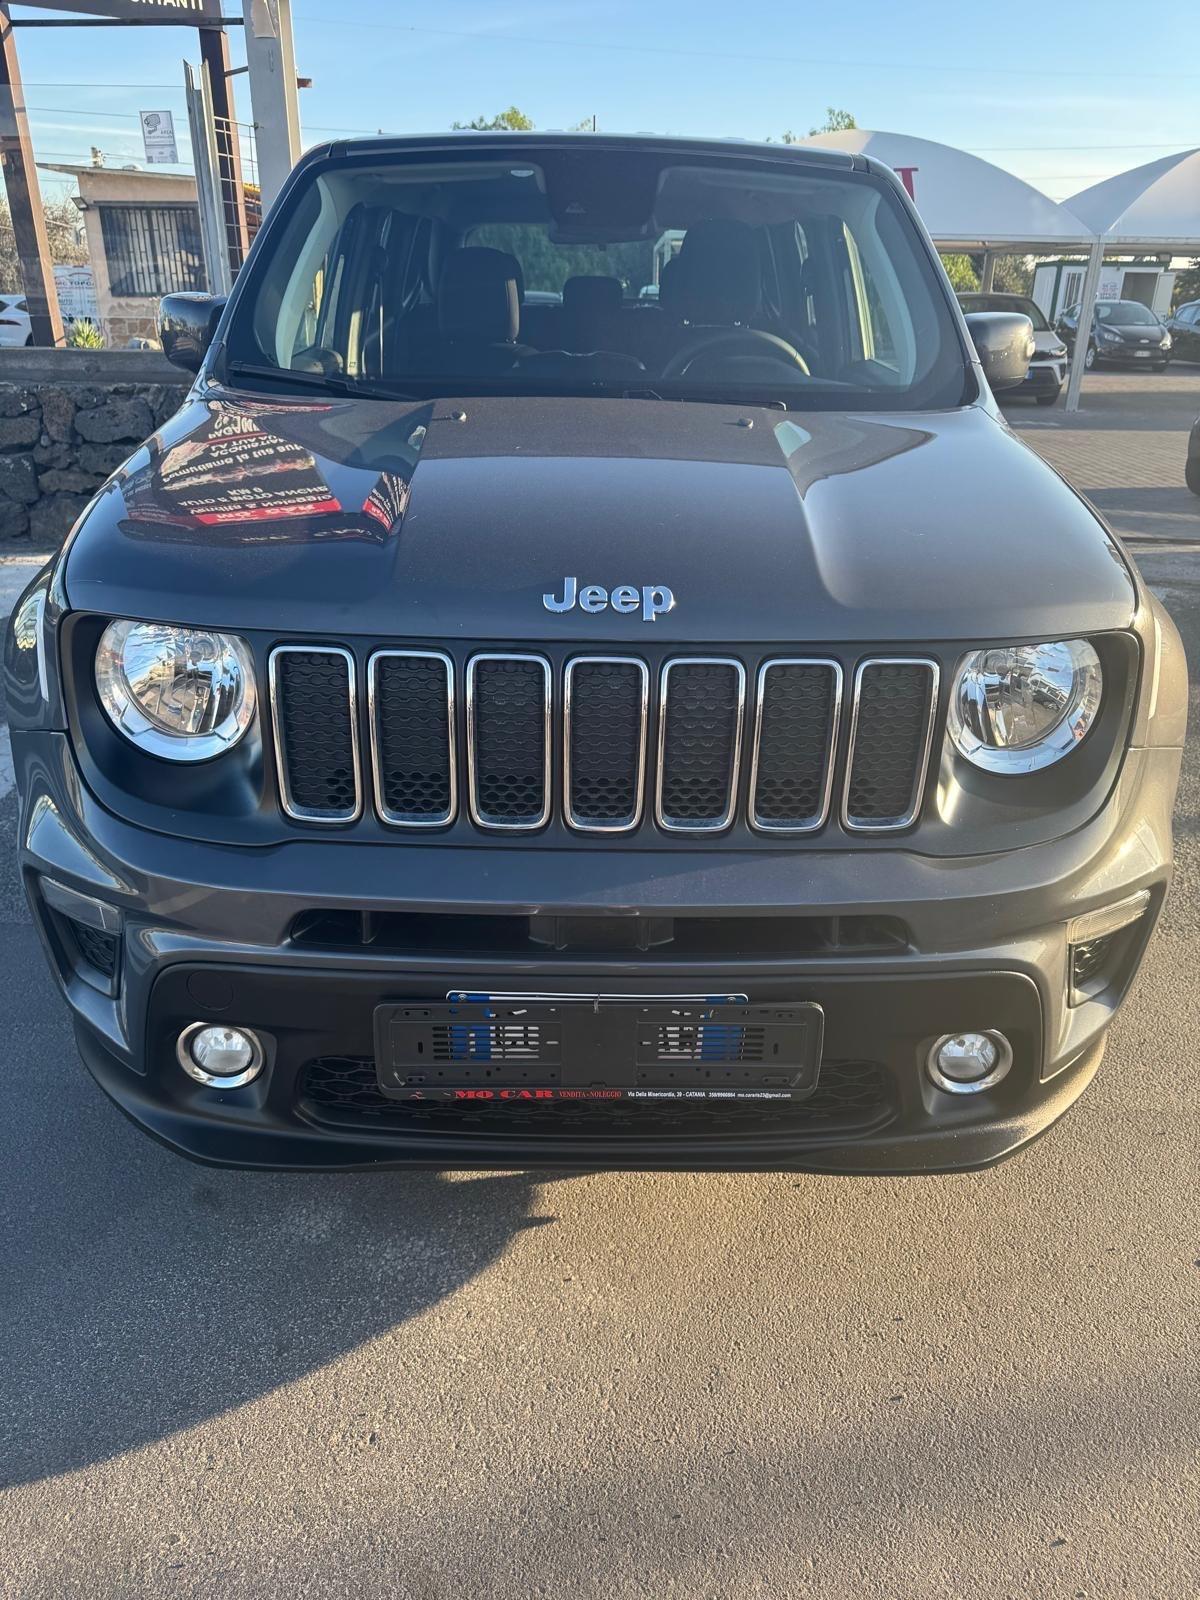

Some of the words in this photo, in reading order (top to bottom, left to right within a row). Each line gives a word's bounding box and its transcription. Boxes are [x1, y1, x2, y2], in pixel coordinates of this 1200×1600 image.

[542, 576, 675, 622] Jeep
[454, 1089, 494, 1099] MO
[500, 1089, 554, 1099] CAR
[559, 1090, 586, 1098] VENDITA
[590, 1090, 622, 1098] NOLEGGIO
